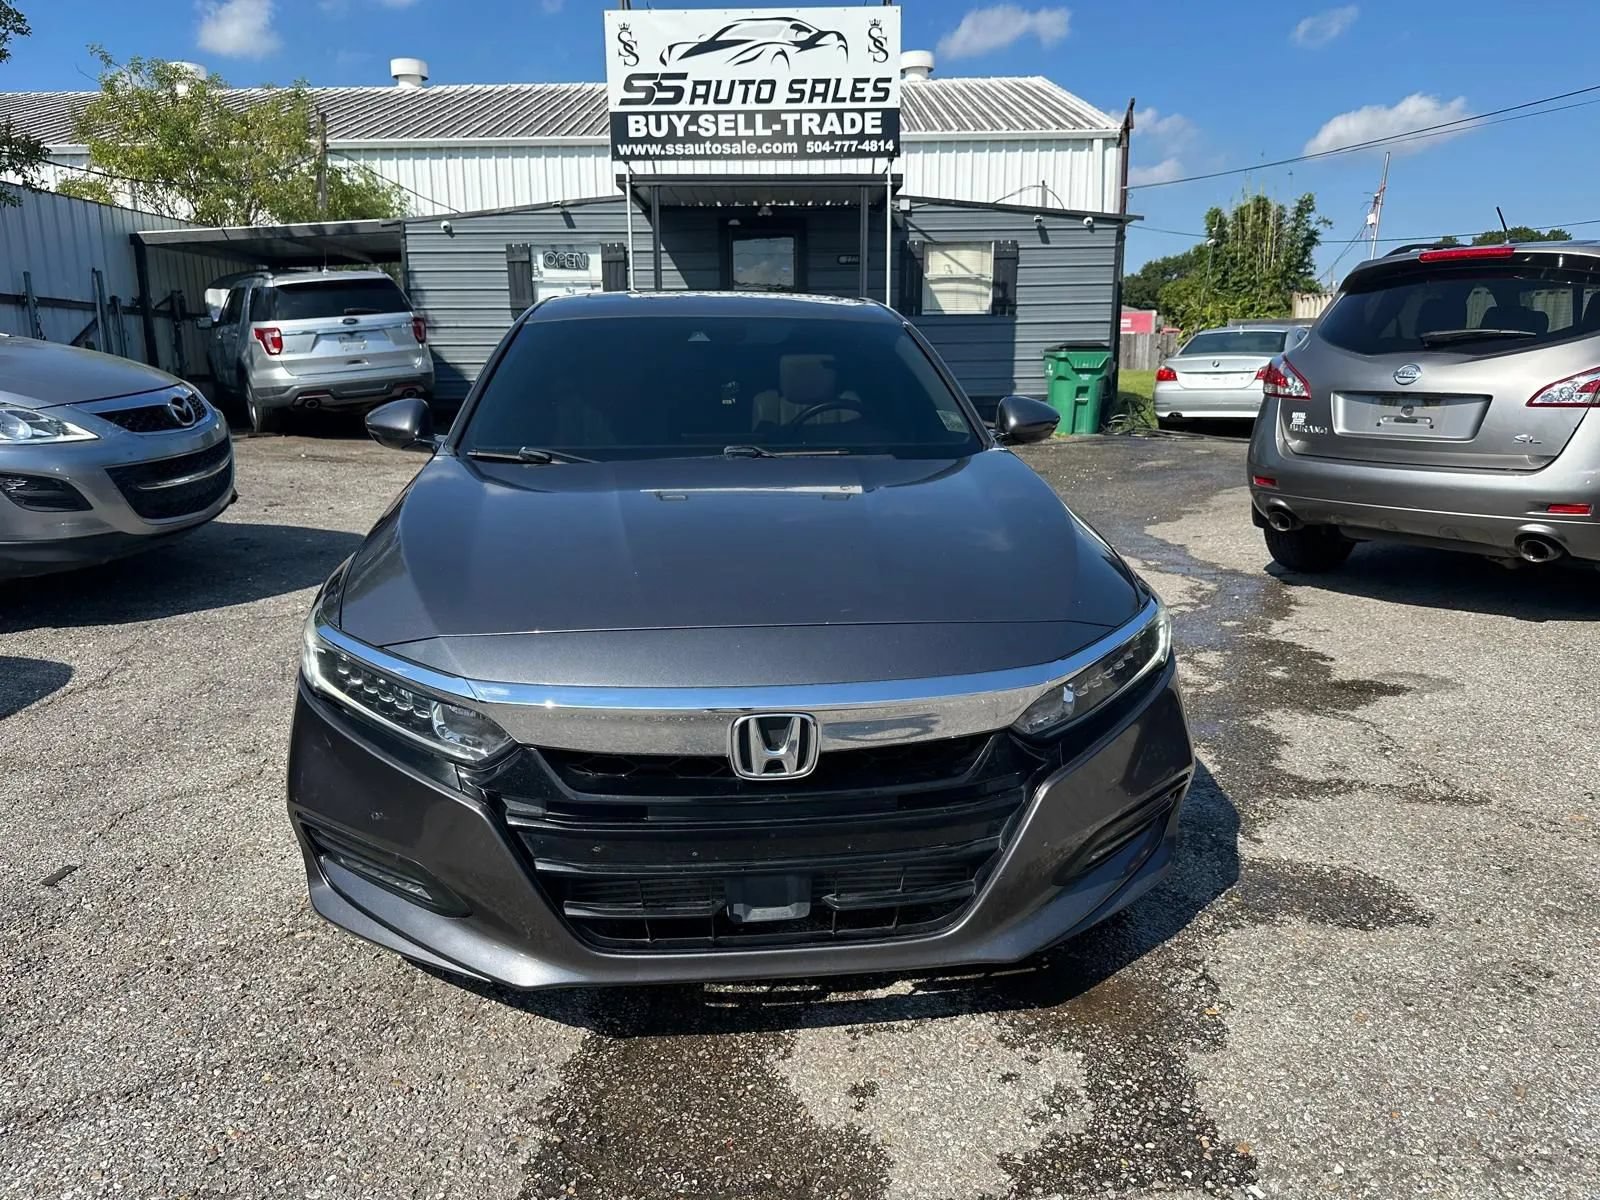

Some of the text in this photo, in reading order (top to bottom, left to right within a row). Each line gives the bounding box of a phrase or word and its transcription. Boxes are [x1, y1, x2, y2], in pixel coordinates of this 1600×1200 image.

[689, 78, 777, 105] AUTO
[785, 77, 893, 105] SALES
[627, 112, 883, 138] BUY-SELL-TRADE
[617, 140, 894, 156] www.ssautosale.com 504-777-4814
[543, 251, 588, 269] OPEN
